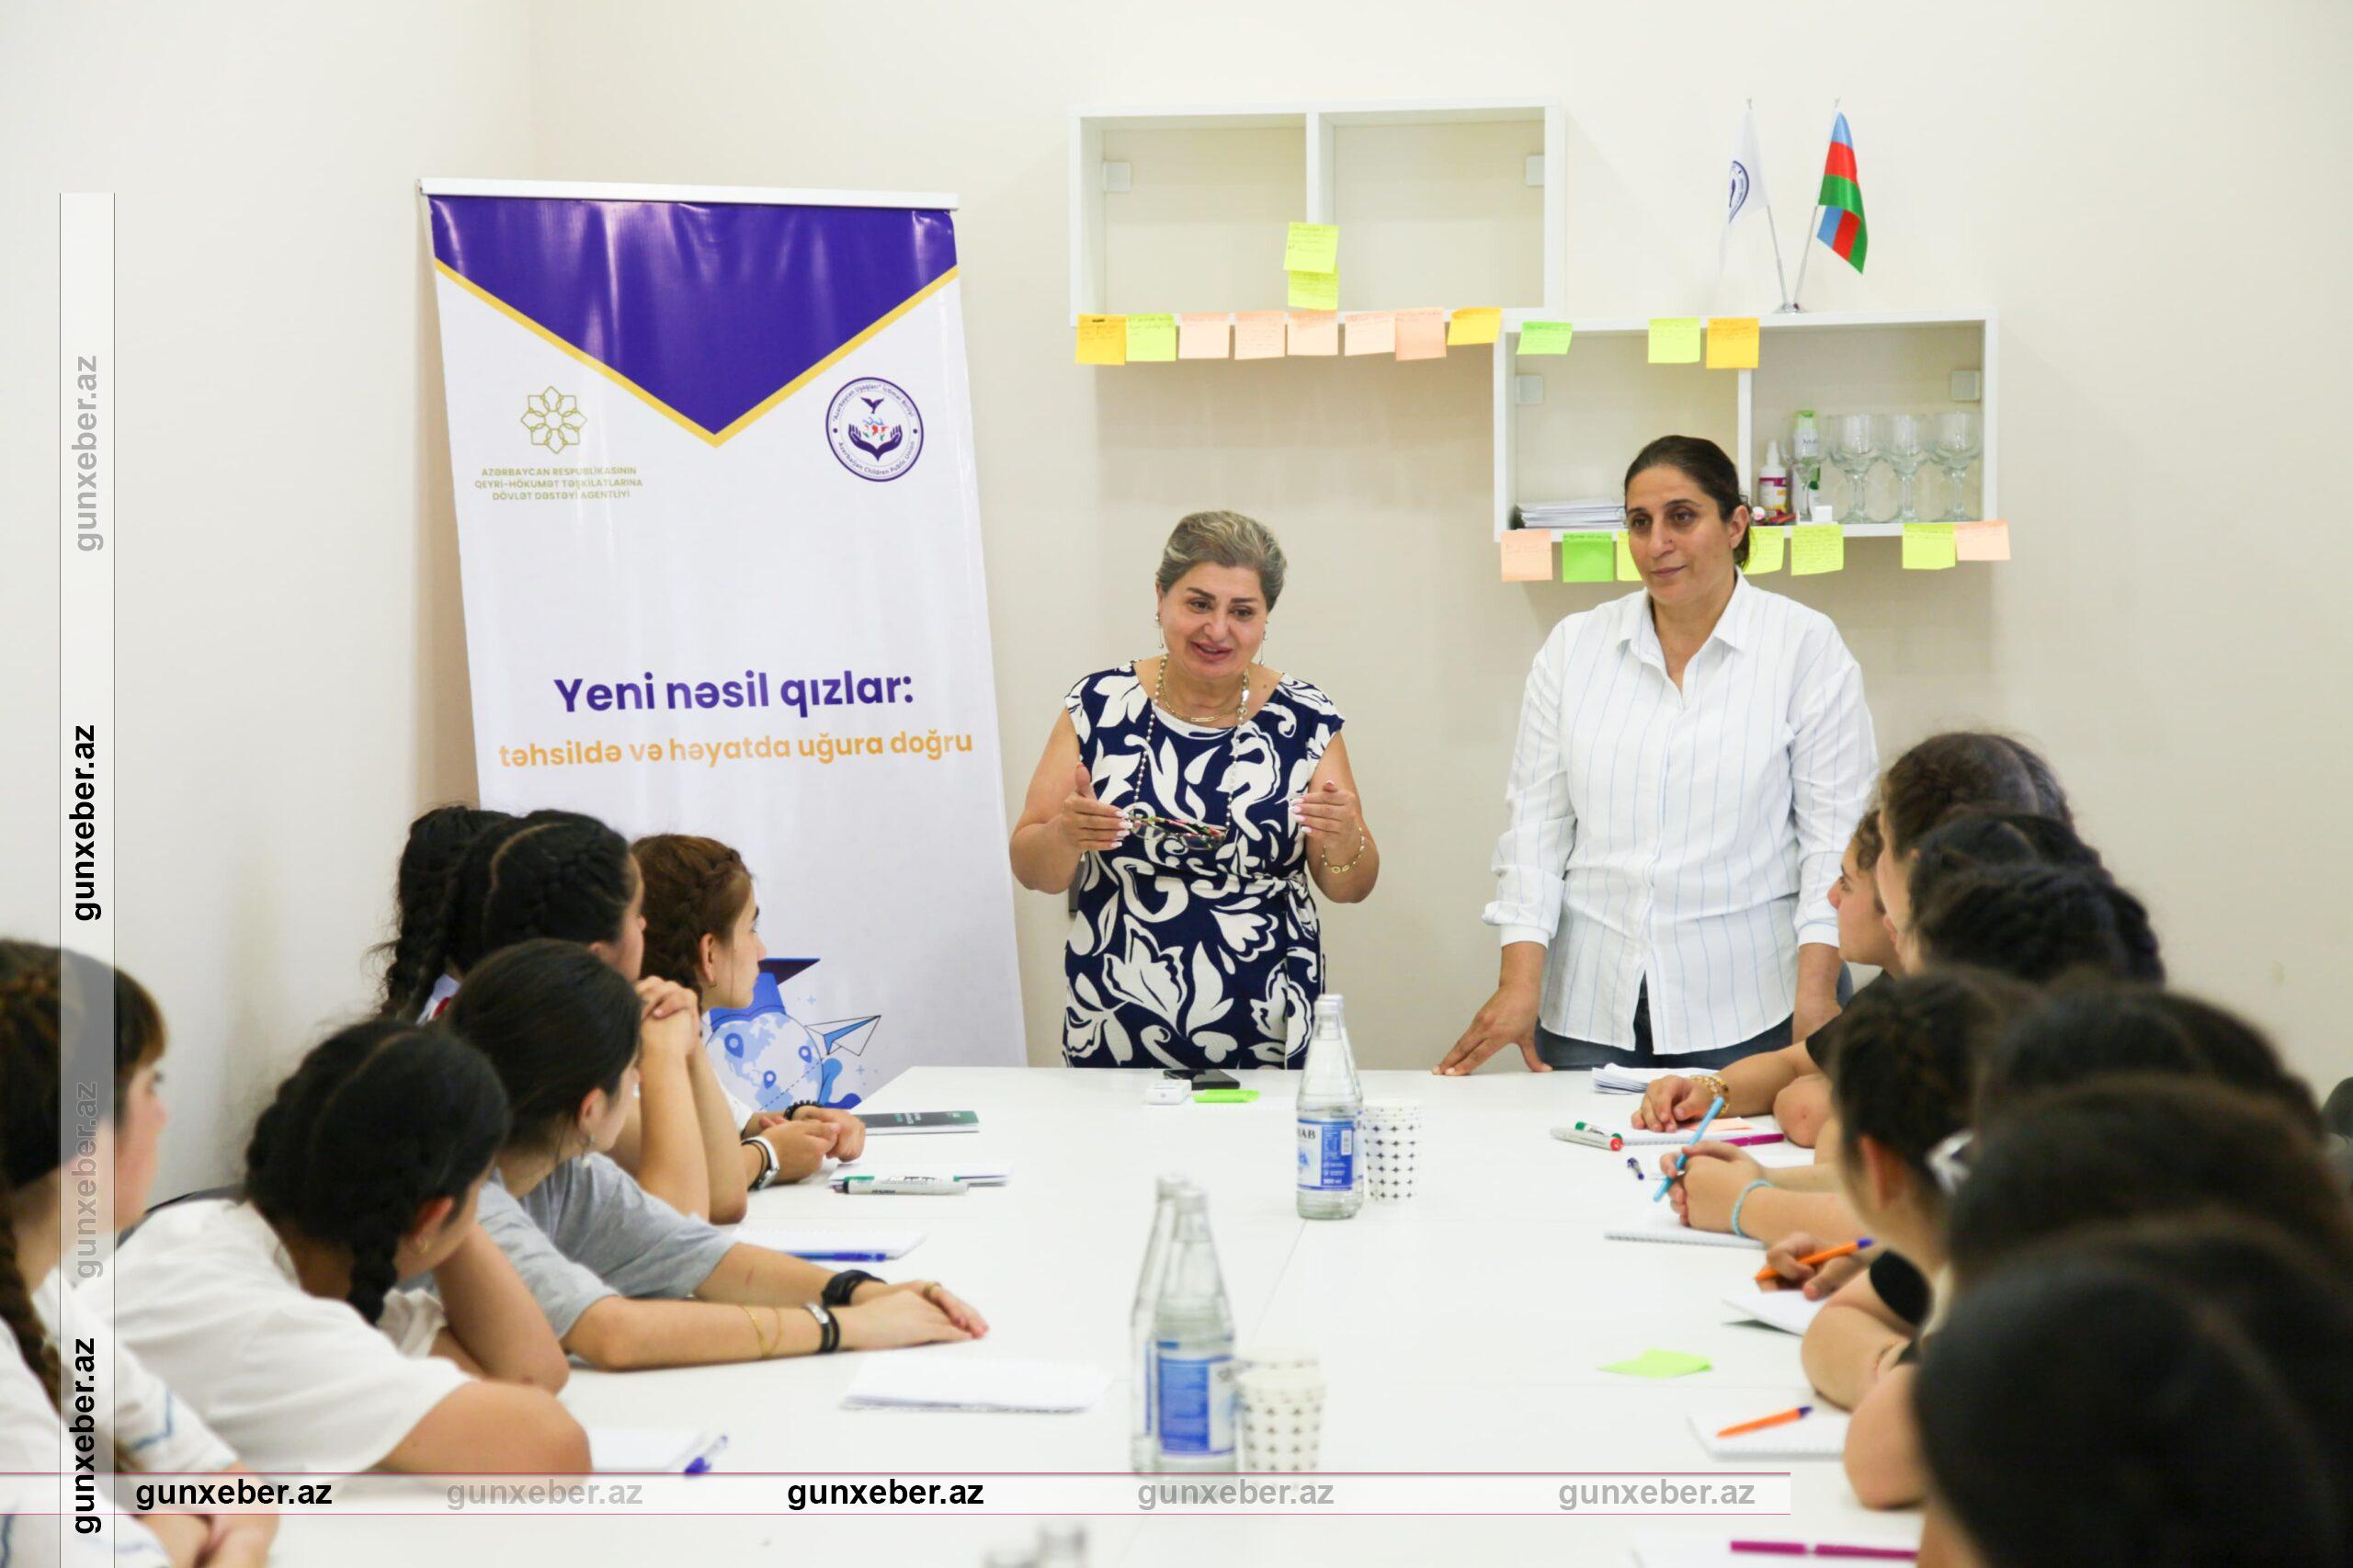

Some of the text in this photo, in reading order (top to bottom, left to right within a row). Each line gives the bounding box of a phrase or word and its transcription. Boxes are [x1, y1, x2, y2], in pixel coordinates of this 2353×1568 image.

[482, 467, 550, 477] AZƏRBAYCAN
[493, 490, 532, 501] DÖVLƏT
[553, 670, 914, 718] Yeni nəsil qızlar:
[498, 729, 972, 768] təhsildə və həyatda uğura doğru
